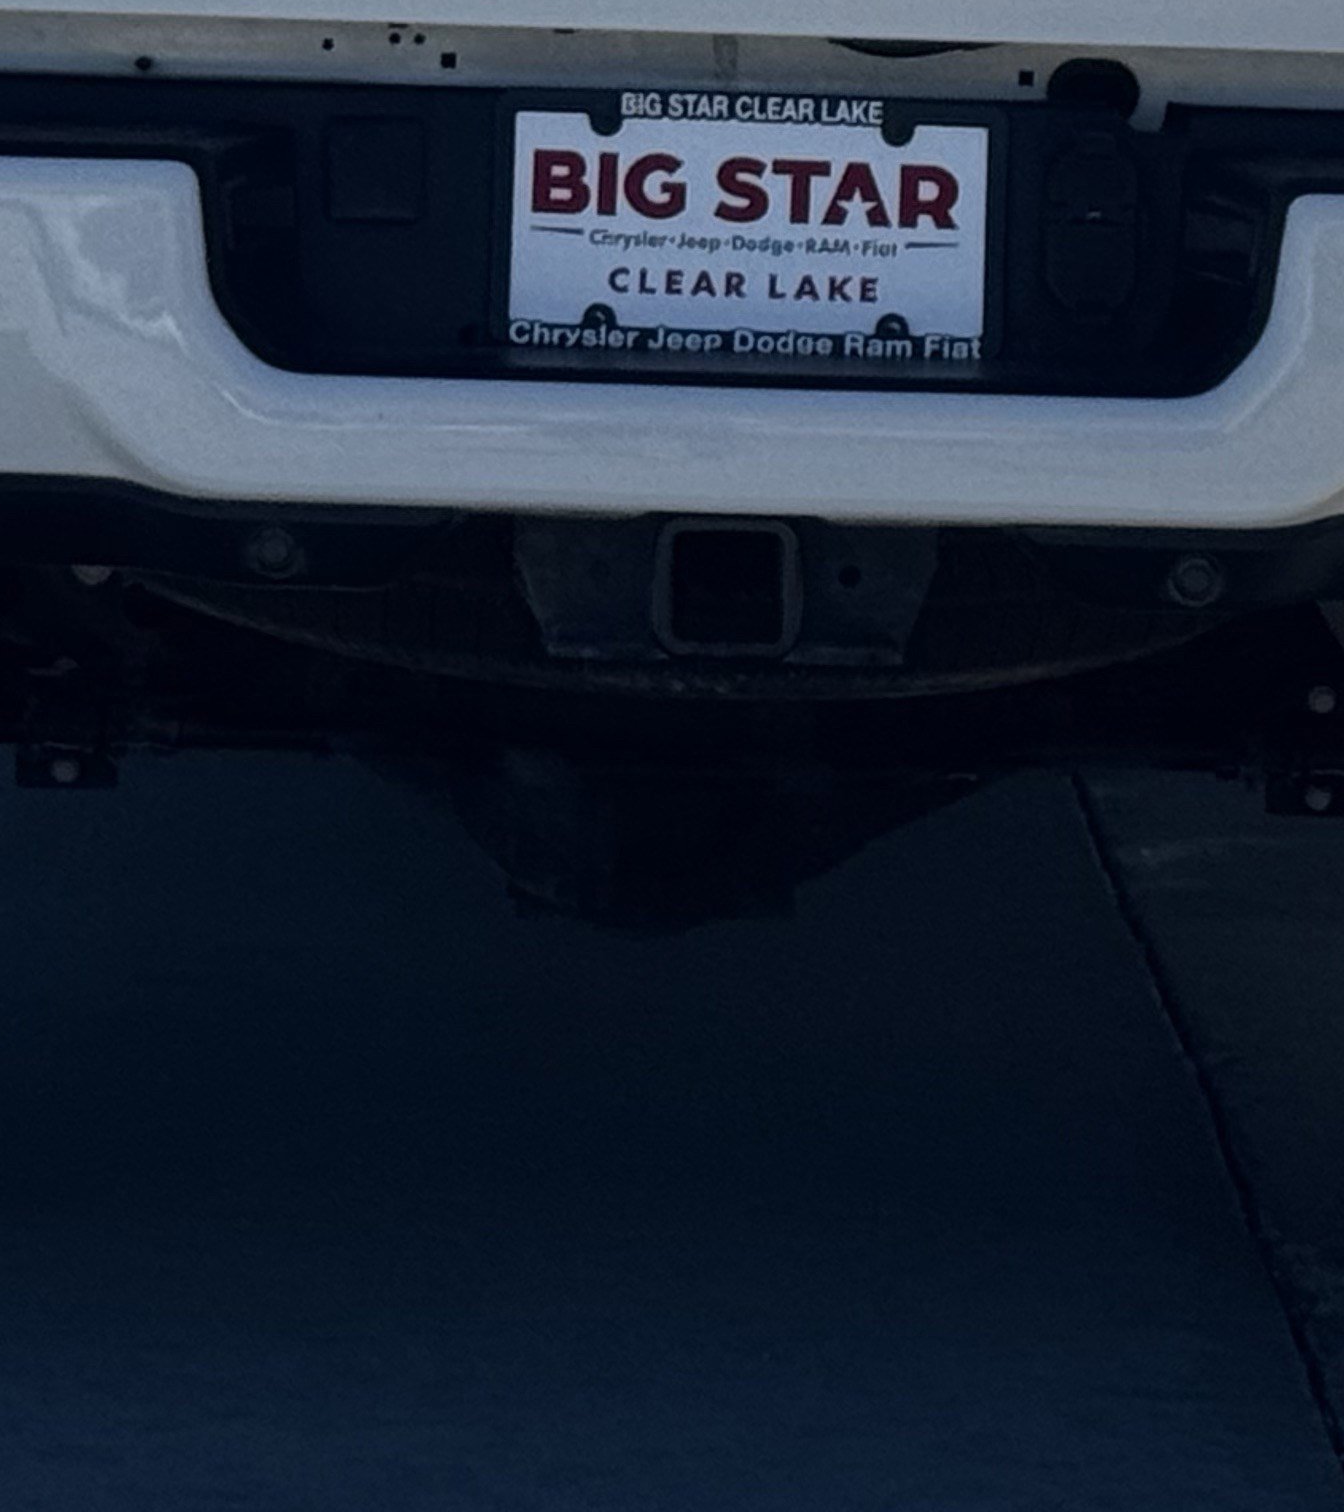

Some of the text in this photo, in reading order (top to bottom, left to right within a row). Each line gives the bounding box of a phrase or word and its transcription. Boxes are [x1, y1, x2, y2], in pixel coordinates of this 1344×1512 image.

[621, 92, 884, 124] BIG STAR CLEAR LAKE
[531, 148, 960, 230] BIG STAR
[589, 229, 898, 258] Chrysler Jeep Dodge RAM Fiat
[608, 267, 880, 304] CLEAR LAKE
[509, 320, 981, 360] Chrysler Jeep Dodge Ram Fiat
